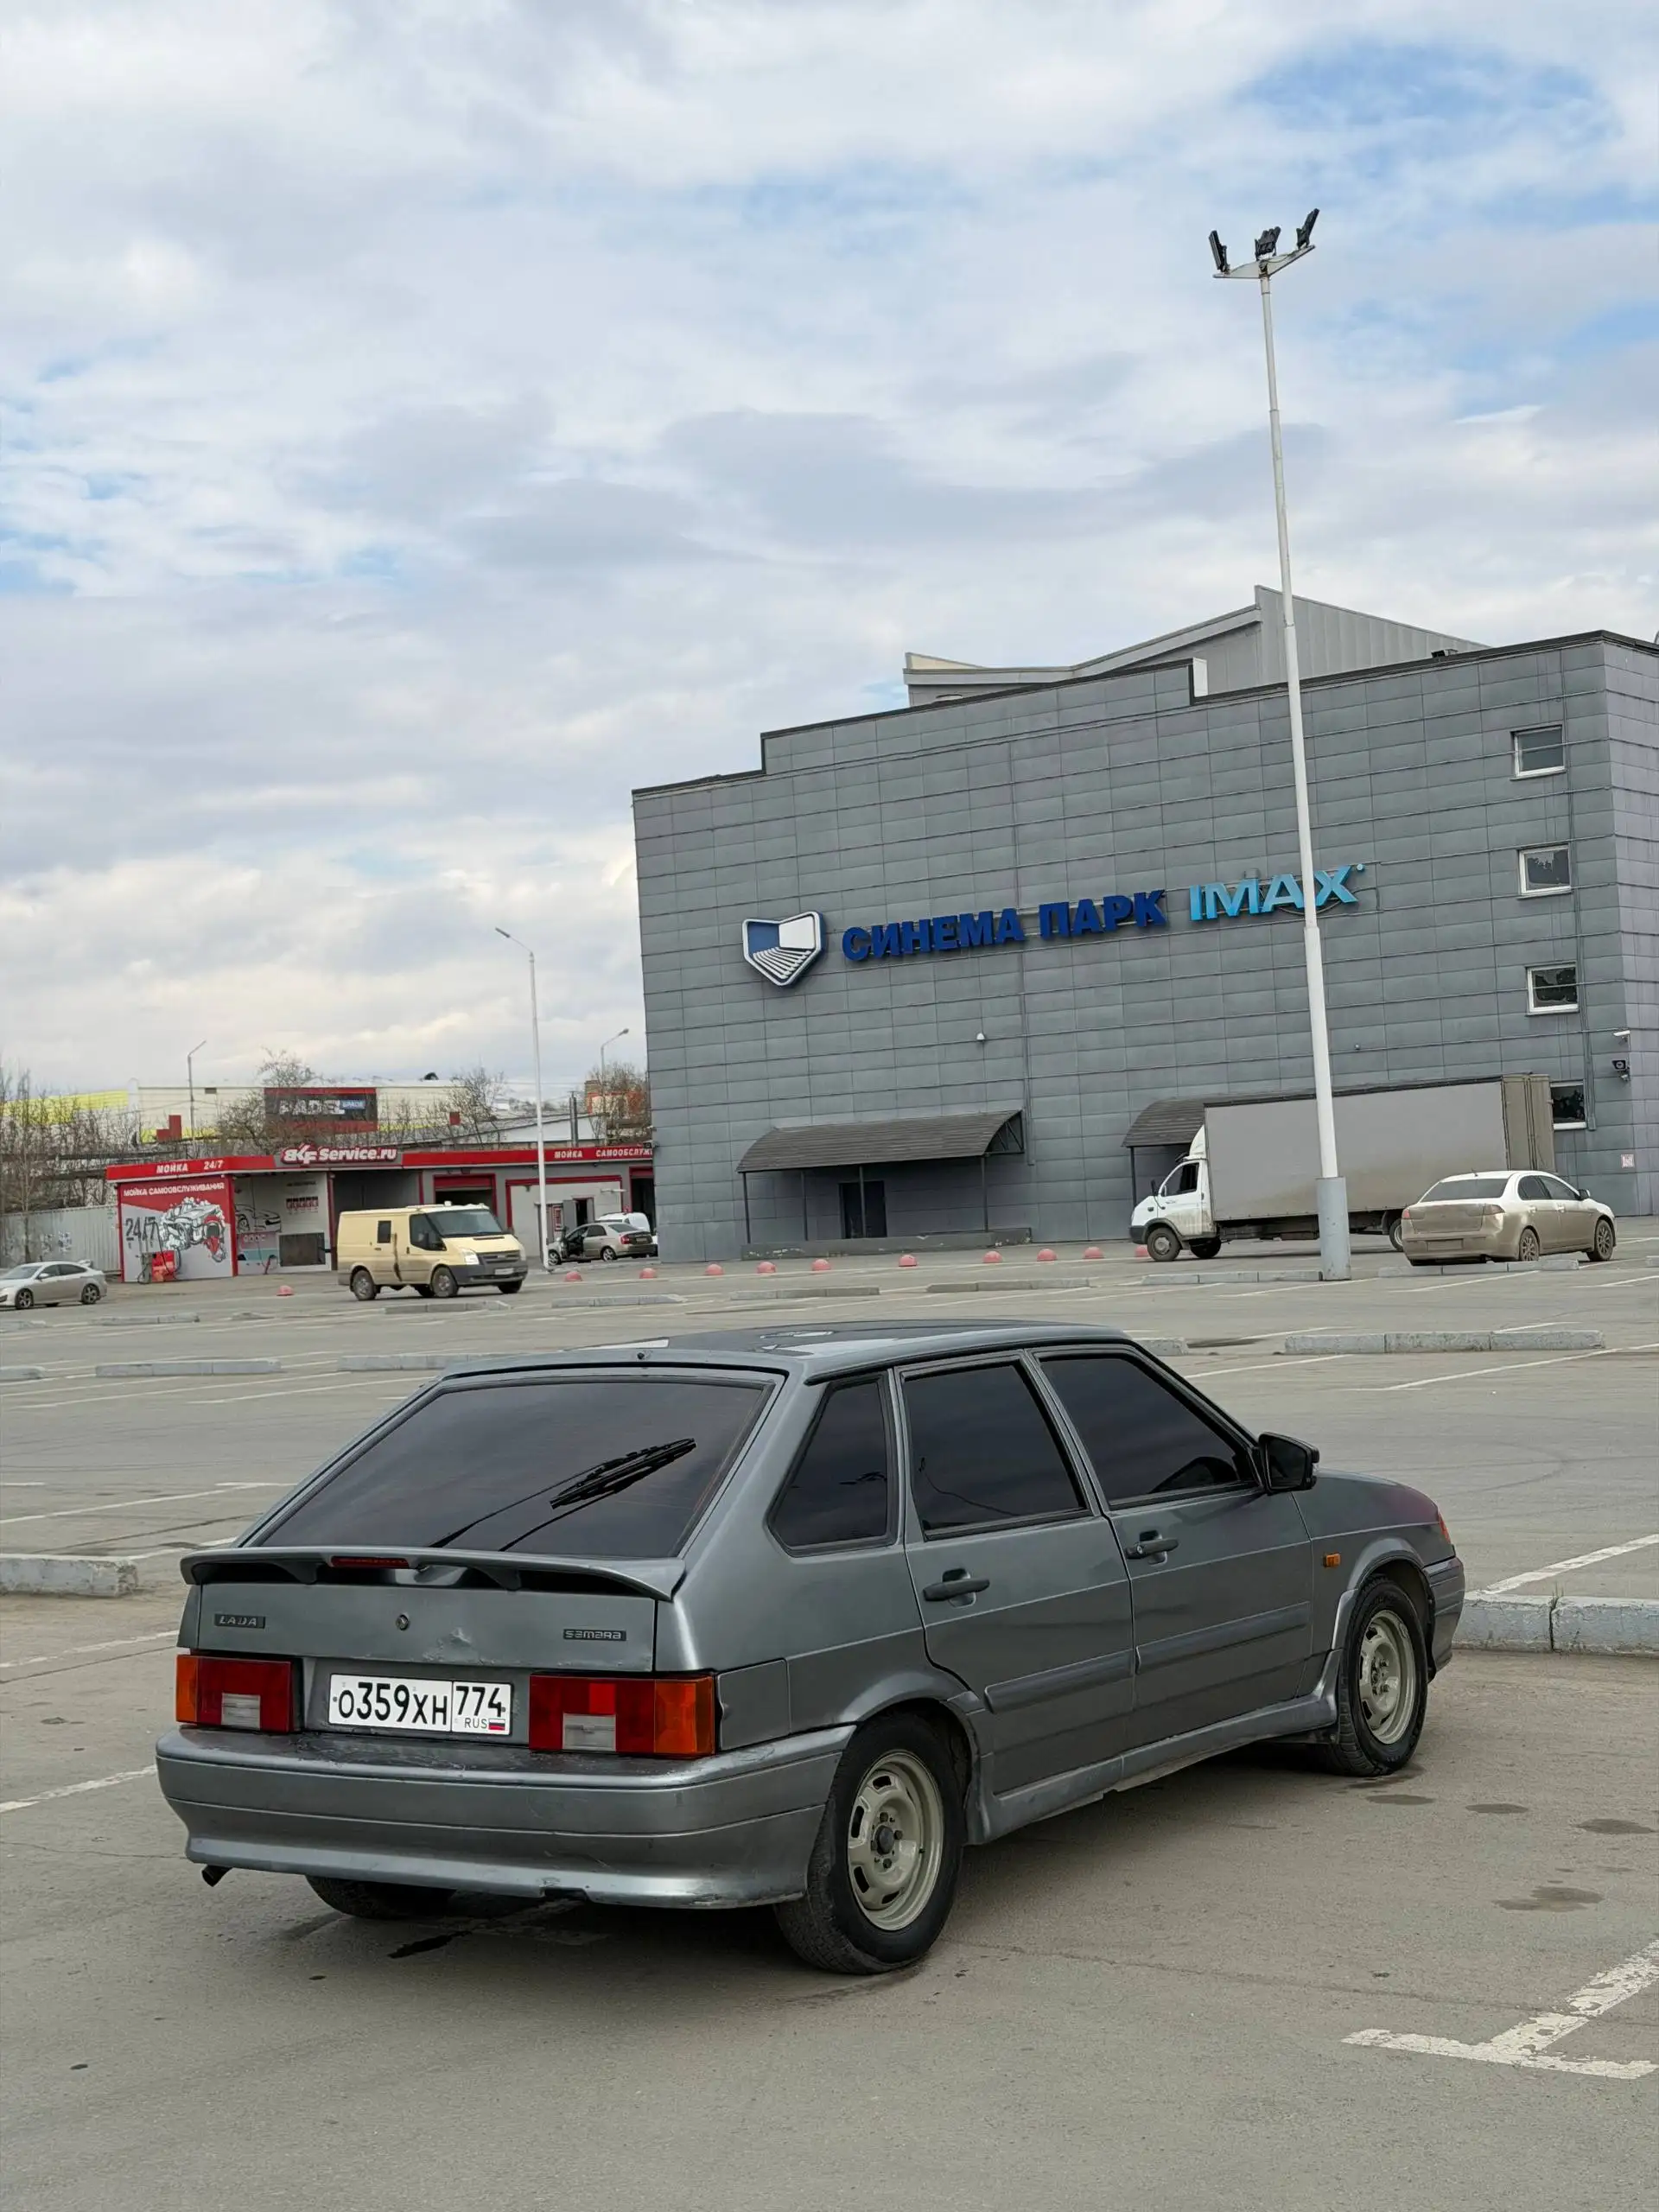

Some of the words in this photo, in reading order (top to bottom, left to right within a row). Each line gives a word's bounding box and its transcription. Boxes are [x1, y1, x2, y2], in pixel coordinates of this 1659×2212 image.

[1189, 864, 1359, 921] IMAX
[842, 907, 1026, 961] СИНЕМА
[1039, 889, 1167, 940] ПАРК
[318, 1147, 397, 1161] Service.ru
[554, 1149, 583, 1159] МОЙКА
[156, 1163, 188, 1173] МОЙКА
[204, 1160, 224, 1170] 24/7
[124, 1187, 148, 1197] МОЙКА
[149, 1182, 225, 1195] САМООБСЛУЖИВАНИЯ
[219, 1615, 257, 1626] LADA
[455, 1686, 502, 1718] 774
[464, 1717, 487, 1729] RUS
